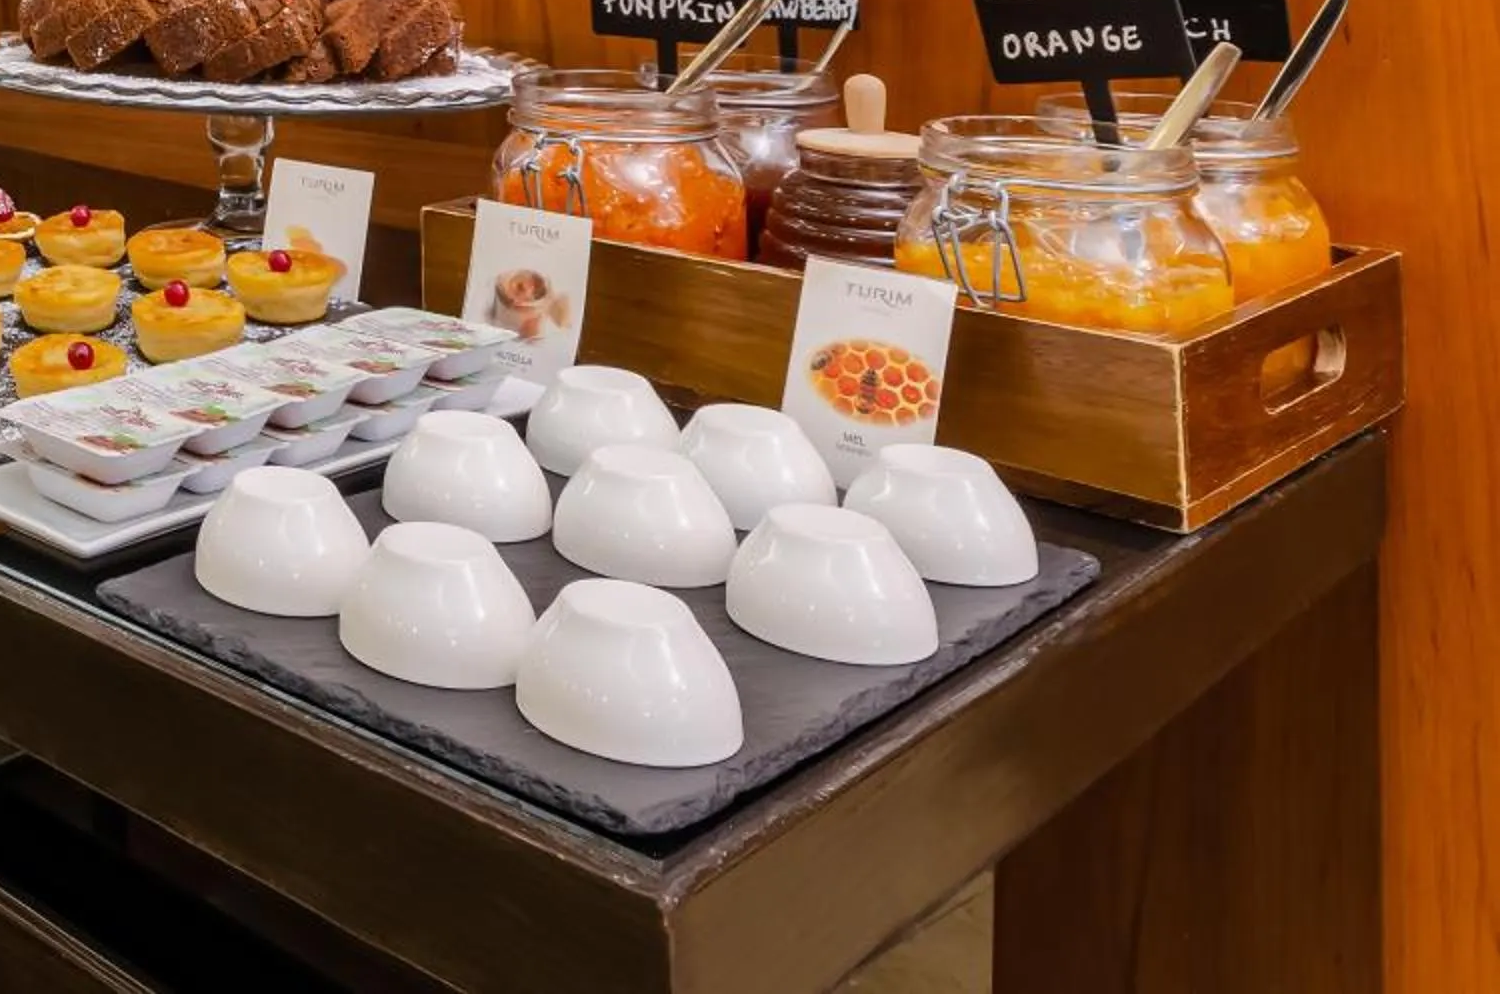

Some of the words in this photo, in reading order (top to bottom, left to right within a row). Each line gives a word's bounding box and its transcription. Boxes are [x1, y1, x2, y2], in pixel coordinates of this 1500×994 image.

[1003, 24, 1143, 59] ORANGE
[509, 220, 560, 244] TURIM
[845, 281, 914, 308] TURIM
